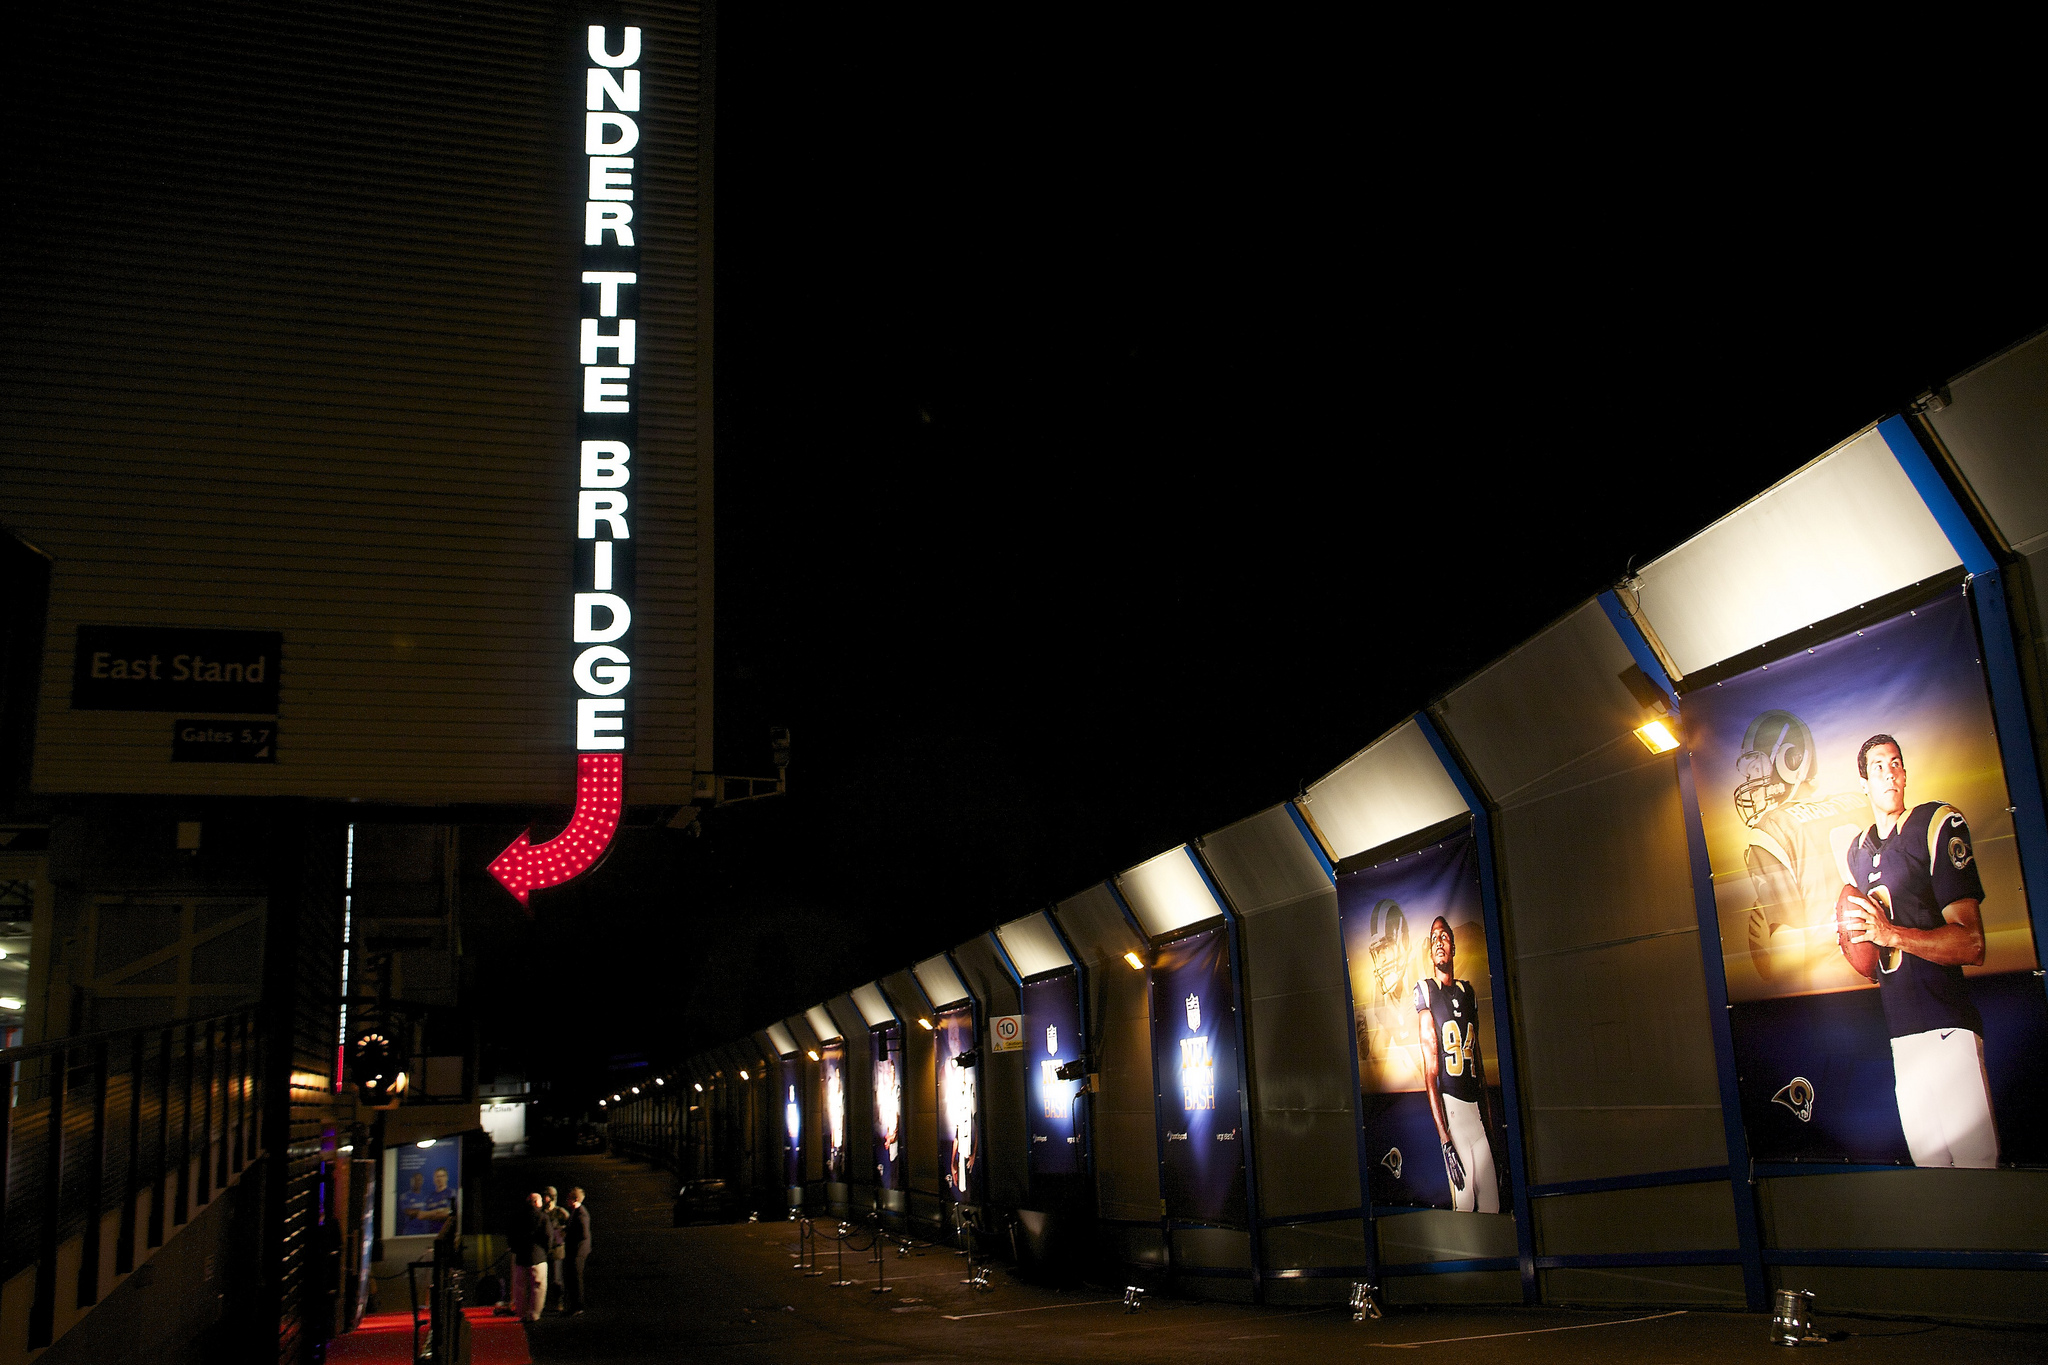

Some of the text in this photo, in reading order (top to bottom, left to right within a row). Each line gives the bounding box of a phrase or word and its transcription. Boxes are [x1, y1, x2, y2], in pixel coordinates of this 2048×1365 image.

[573, 25, 641, 750] UNDER THE BRIDGE
[90, 651, 266, 683] East Stand
[180, 727, 234, 743] Gates
[1000, 1023, 1015, 1035] 10
[1441, 1020, 1476, 1078] 94
[1184, 1085, 1215, 1110] BASH
